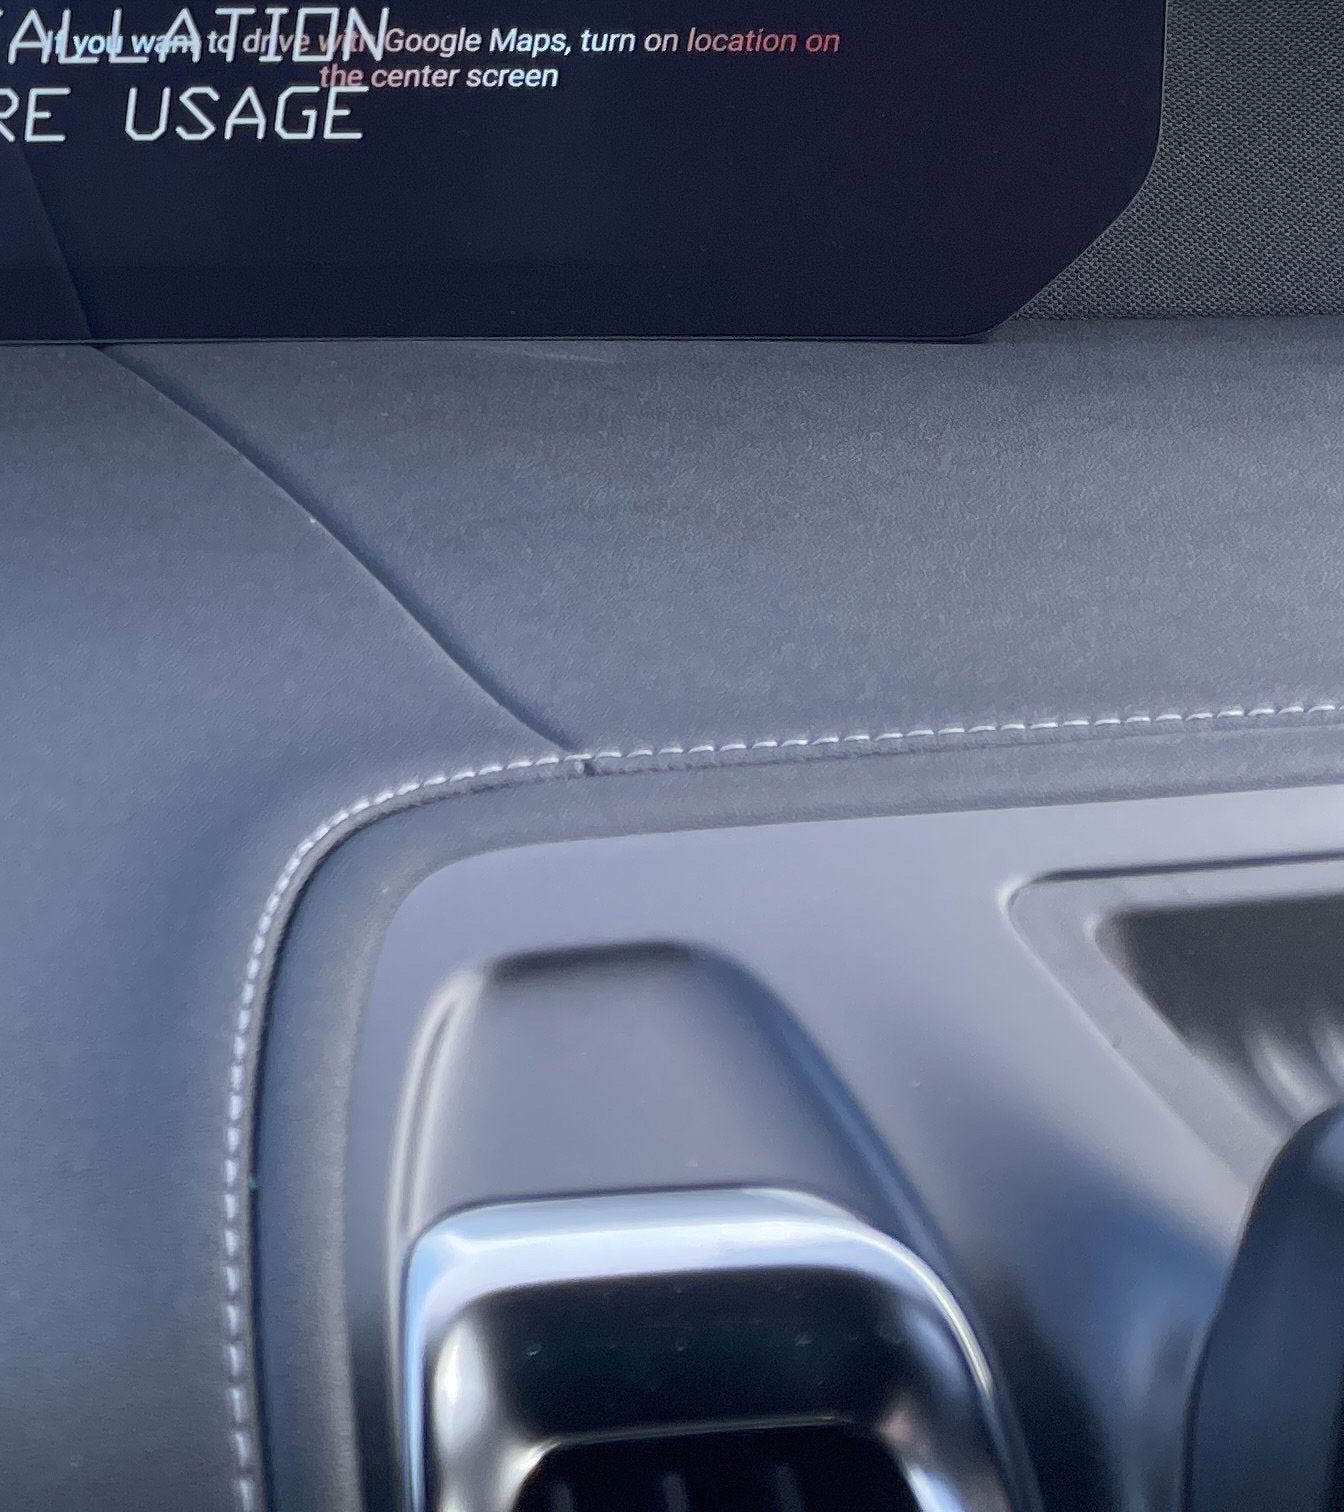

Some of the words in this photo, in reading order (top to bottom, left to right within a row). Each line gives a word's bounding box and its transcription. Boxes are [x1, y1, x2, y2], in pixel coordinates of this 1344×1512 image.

[384, 27, 483, 59] Google
[488, 27, 572, 59] Maps,
[580, 29, 637, 54] turn
[643, 32, 679, 53] on
[686, 27, 798, 54] location
[804, 32, 841, 54] on
[319, 63, 365, 88] the
[370, 65, 461, 89] center
[465, 67, 559, 89] screen
[124, 85, 369, 141] USAGE
